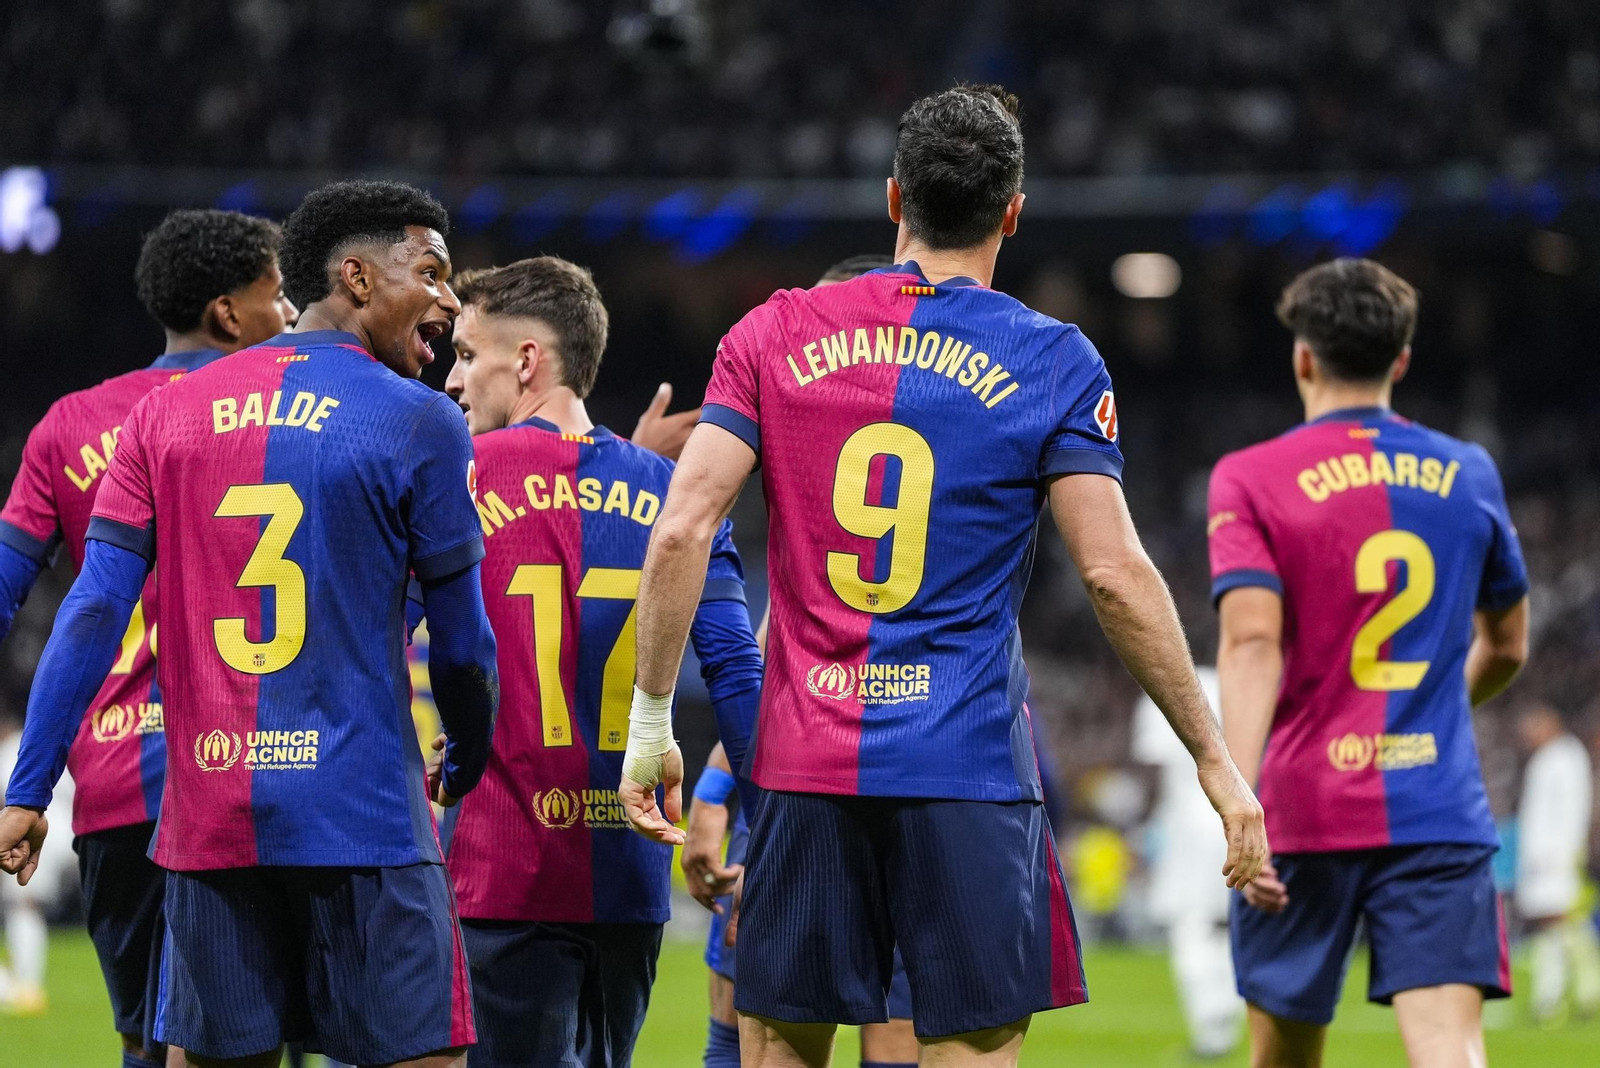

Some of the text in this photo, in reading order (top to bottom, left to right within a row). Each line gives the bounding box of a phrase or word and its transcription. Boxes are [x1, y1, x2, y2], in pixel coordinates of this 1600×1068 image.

[786, 325, 1020, 410] LEWANDOWSKI
[211, 390, 341, 434] BALDE
[825, 421, 935, 615] 9
[212, 482, 307, 675] 3
[1350, 529, 1435, 691] 2
[505, 563, 643, 752] 17
[858, 664, 931, 681] UNHCR
[857, 680, 930, 698] ACNUR
[878, 697, 904, 705] Refugee
[246, 730, 319, 747] UNHCR
[243, 746, 318, 764] ACNUR
[267, 763, 292, 771] Refugee
[292, 762, 317, 770] Agency
